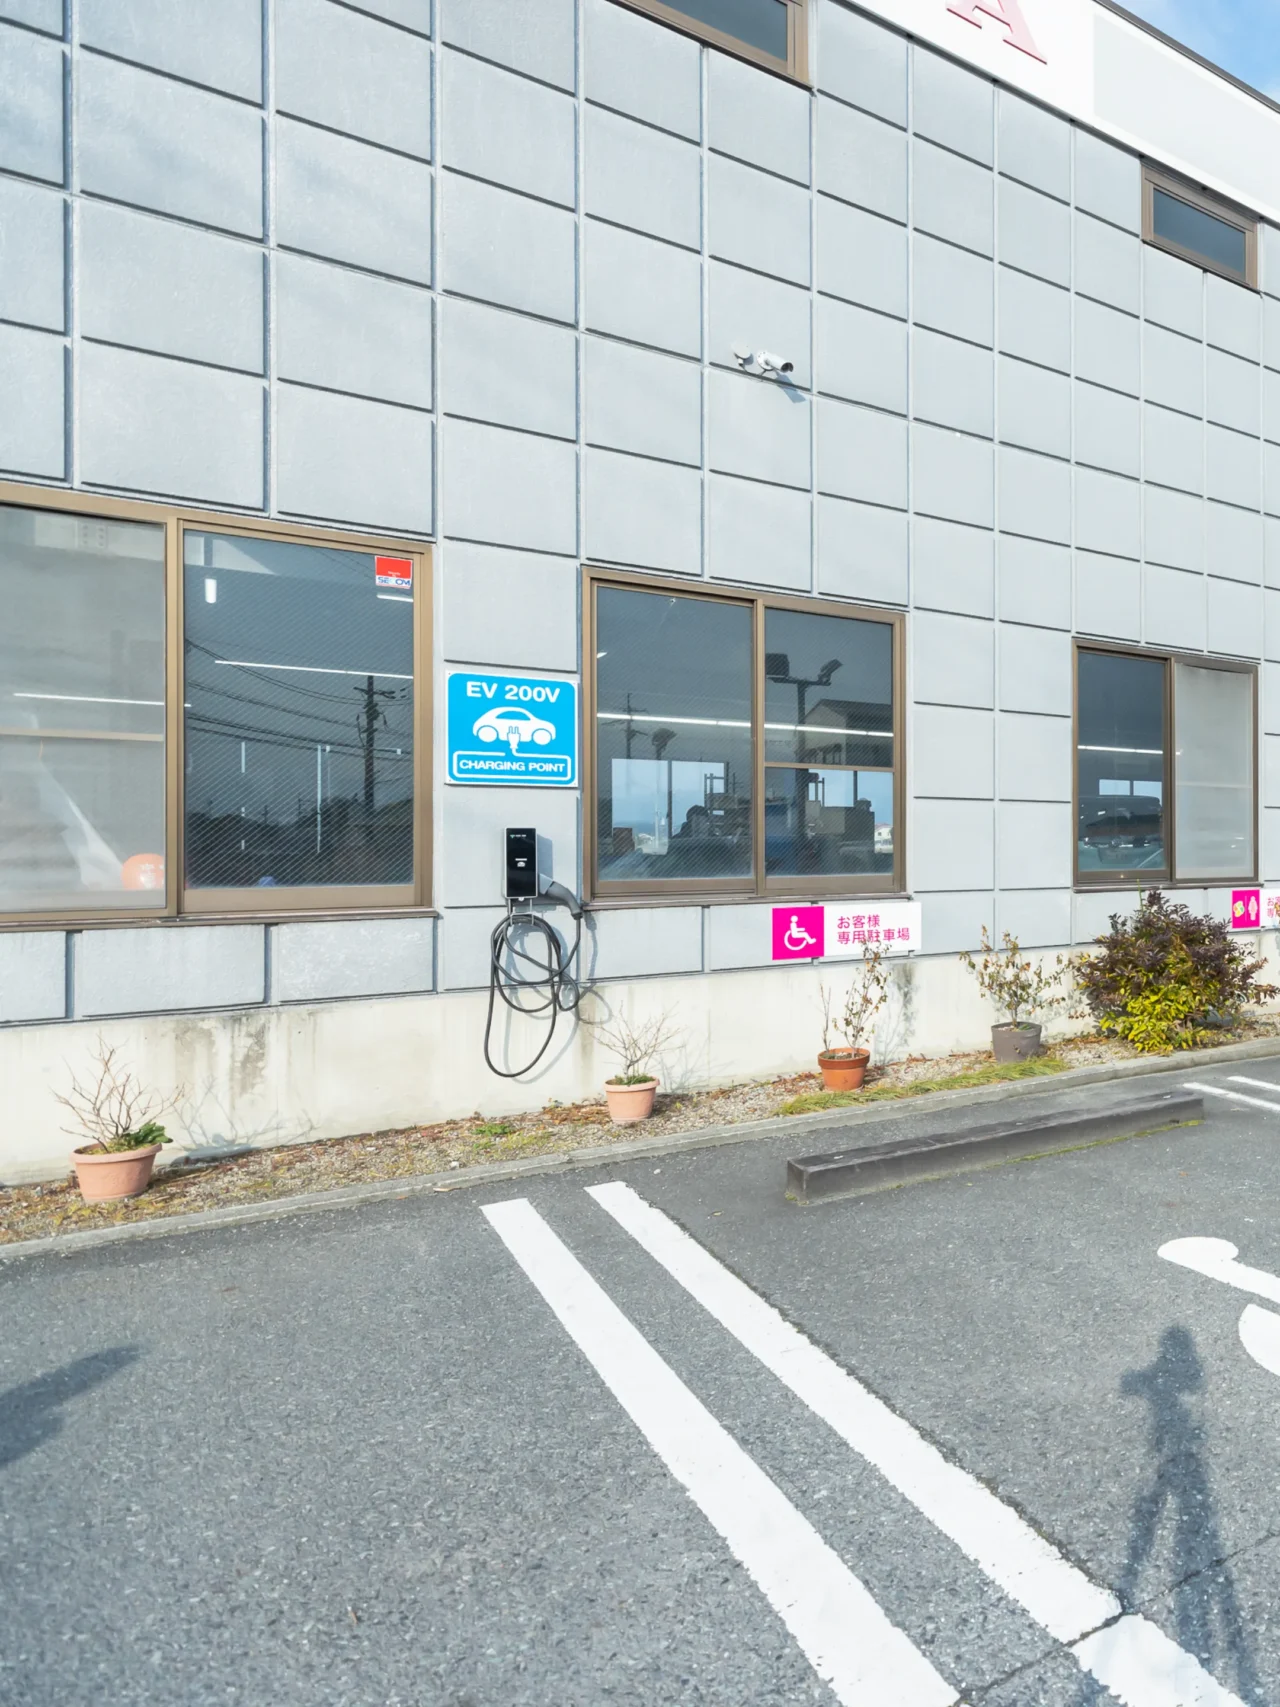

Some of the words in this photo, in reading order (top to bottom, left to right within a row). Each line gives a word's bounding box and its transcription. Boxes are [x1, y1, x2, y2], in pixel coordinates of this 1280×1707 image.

[466, 681, 498, 699] EV
[504, 684, 561, 703] 200V
[459, 759, 526, 771] CHARGING
[528, 762, 565, 772] POINT
[837, 914, 880, 929] お客様
[837, 927, 910, 945] 専用駐車場
